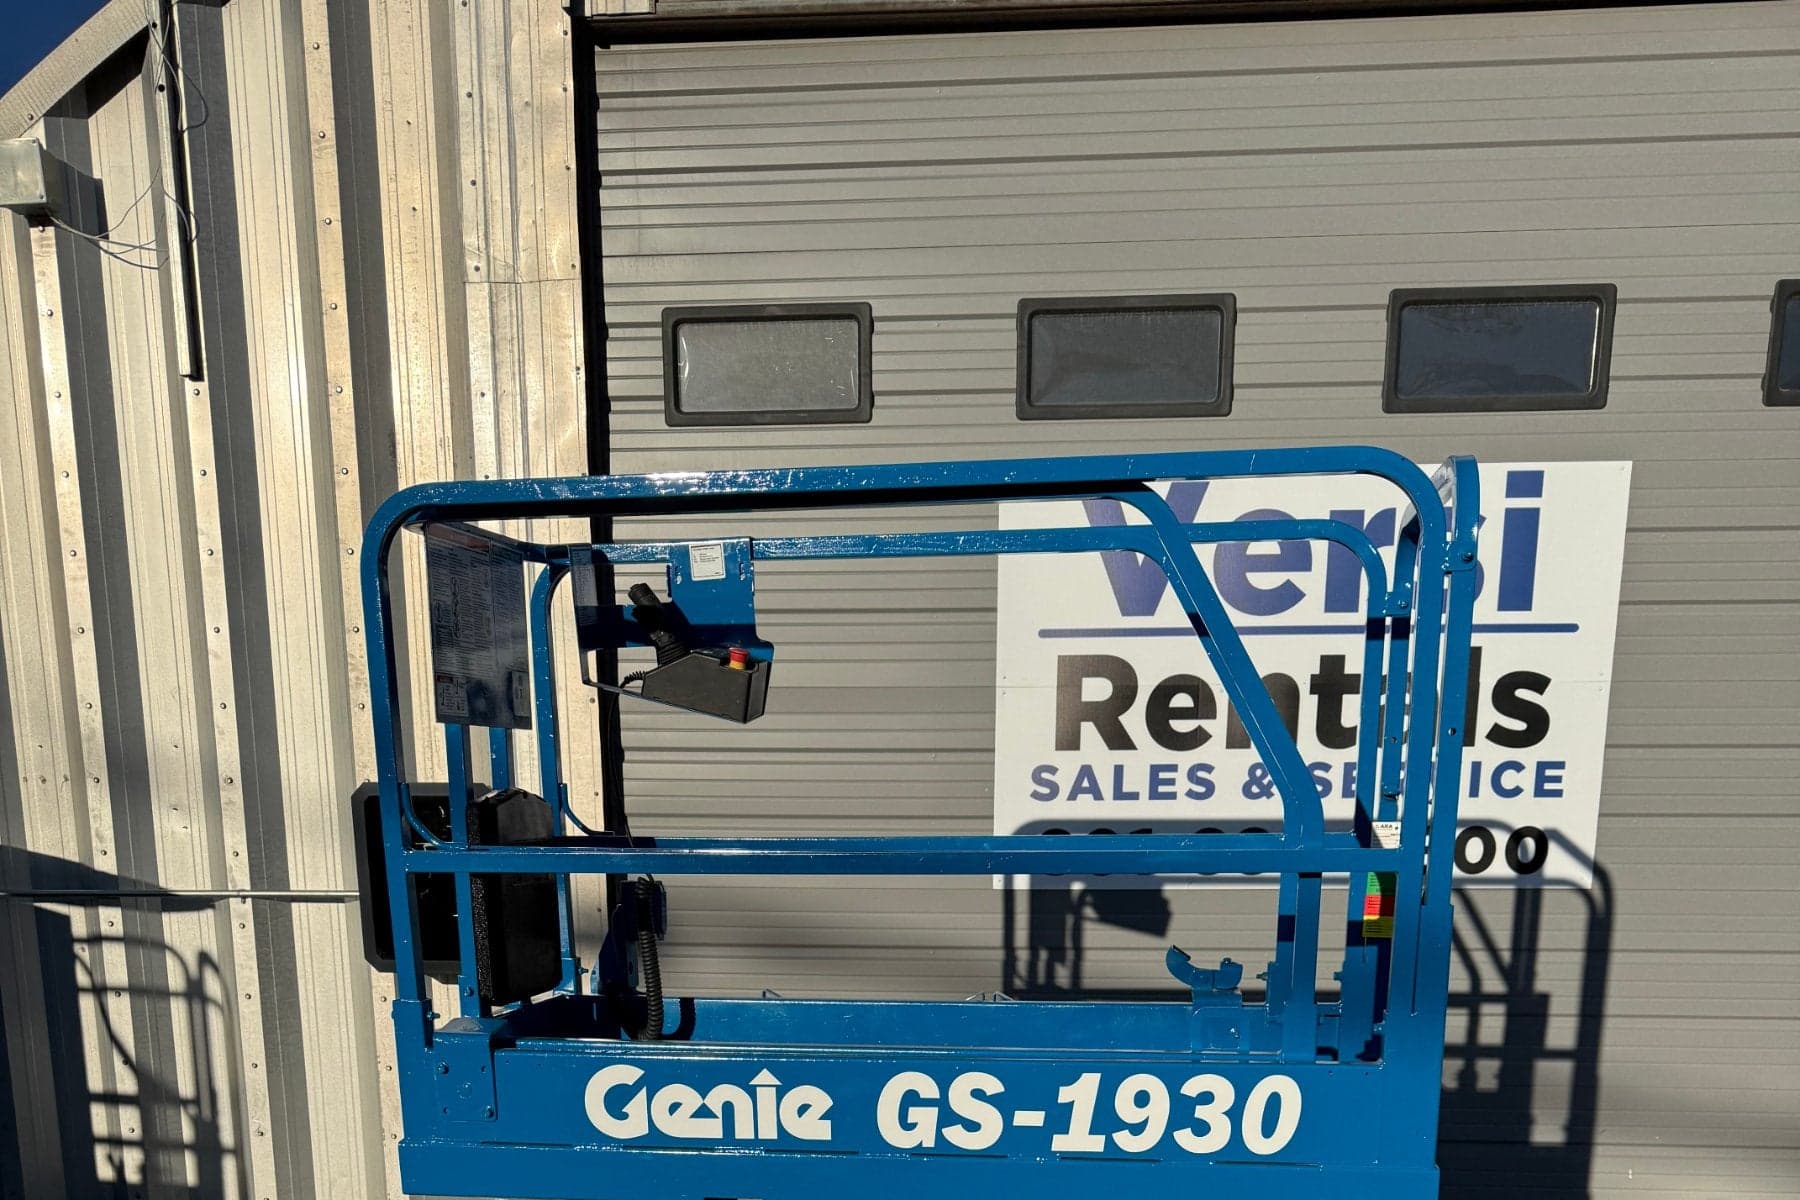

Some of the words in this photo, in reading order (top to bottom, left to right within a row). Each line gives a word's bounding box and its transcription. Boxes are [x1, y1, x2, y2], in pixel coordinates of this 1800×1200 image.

[1081, 469, 1546, 617] Veri
[1054, 646, 1552, 750] Rentls
[1030, 762, 1216, 802] SALES
[1241, 761, 1278, 800] &
[1306, 760, 1566, 798] SEICE
[584, 1063, 834, 1140] Genie
[876, 1071, 1303, 1155] GS-1930
